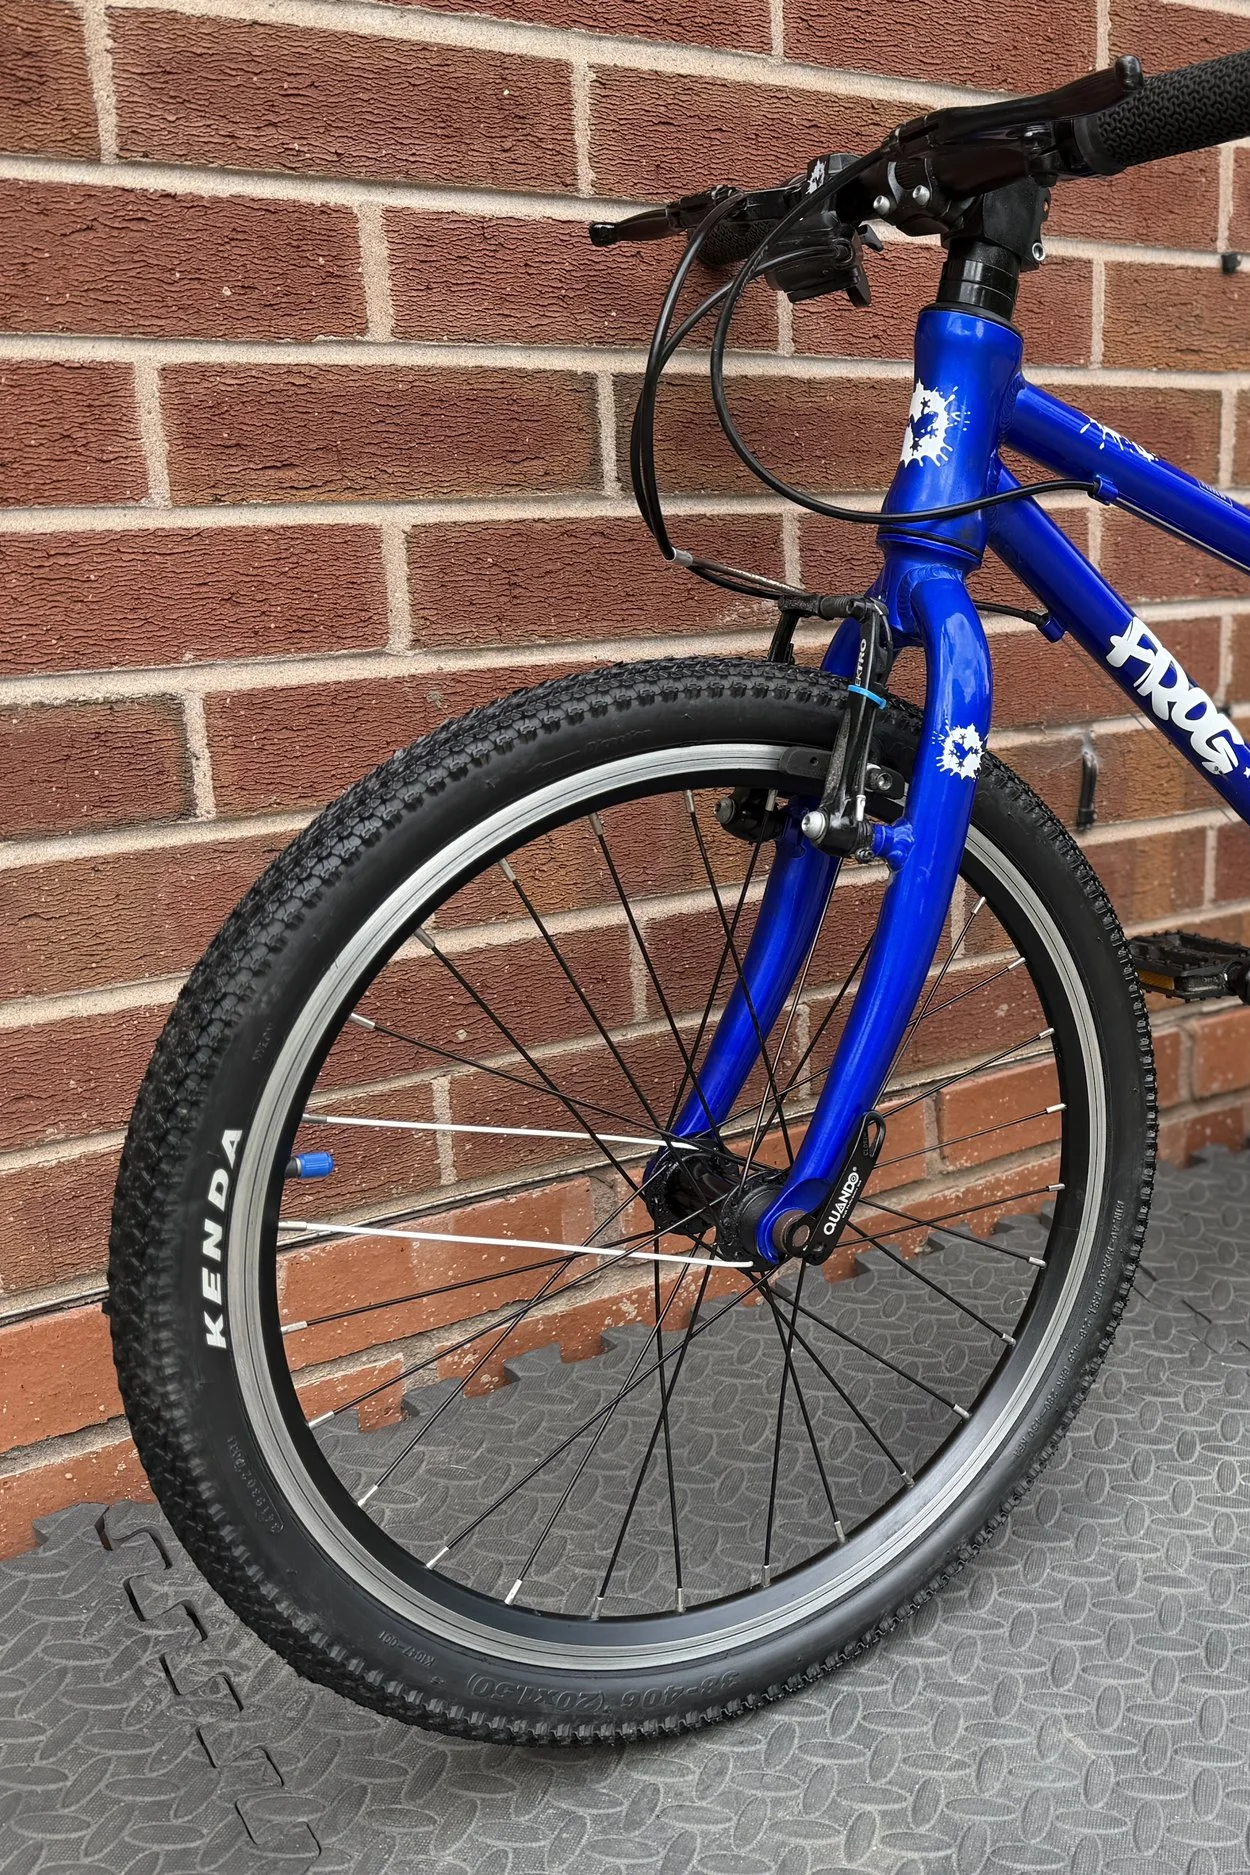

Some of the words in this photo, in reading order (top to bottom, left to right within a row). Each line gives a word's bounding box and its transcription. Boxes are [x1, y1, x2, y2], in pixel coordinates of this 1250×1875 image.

[855, 638, 867, 687] EKTRO
[1106, 617, 1244, 775] FROG
[202, 1129, 243, 1349] KENDA
[823, 1172, 860, 1236] QUANDO
